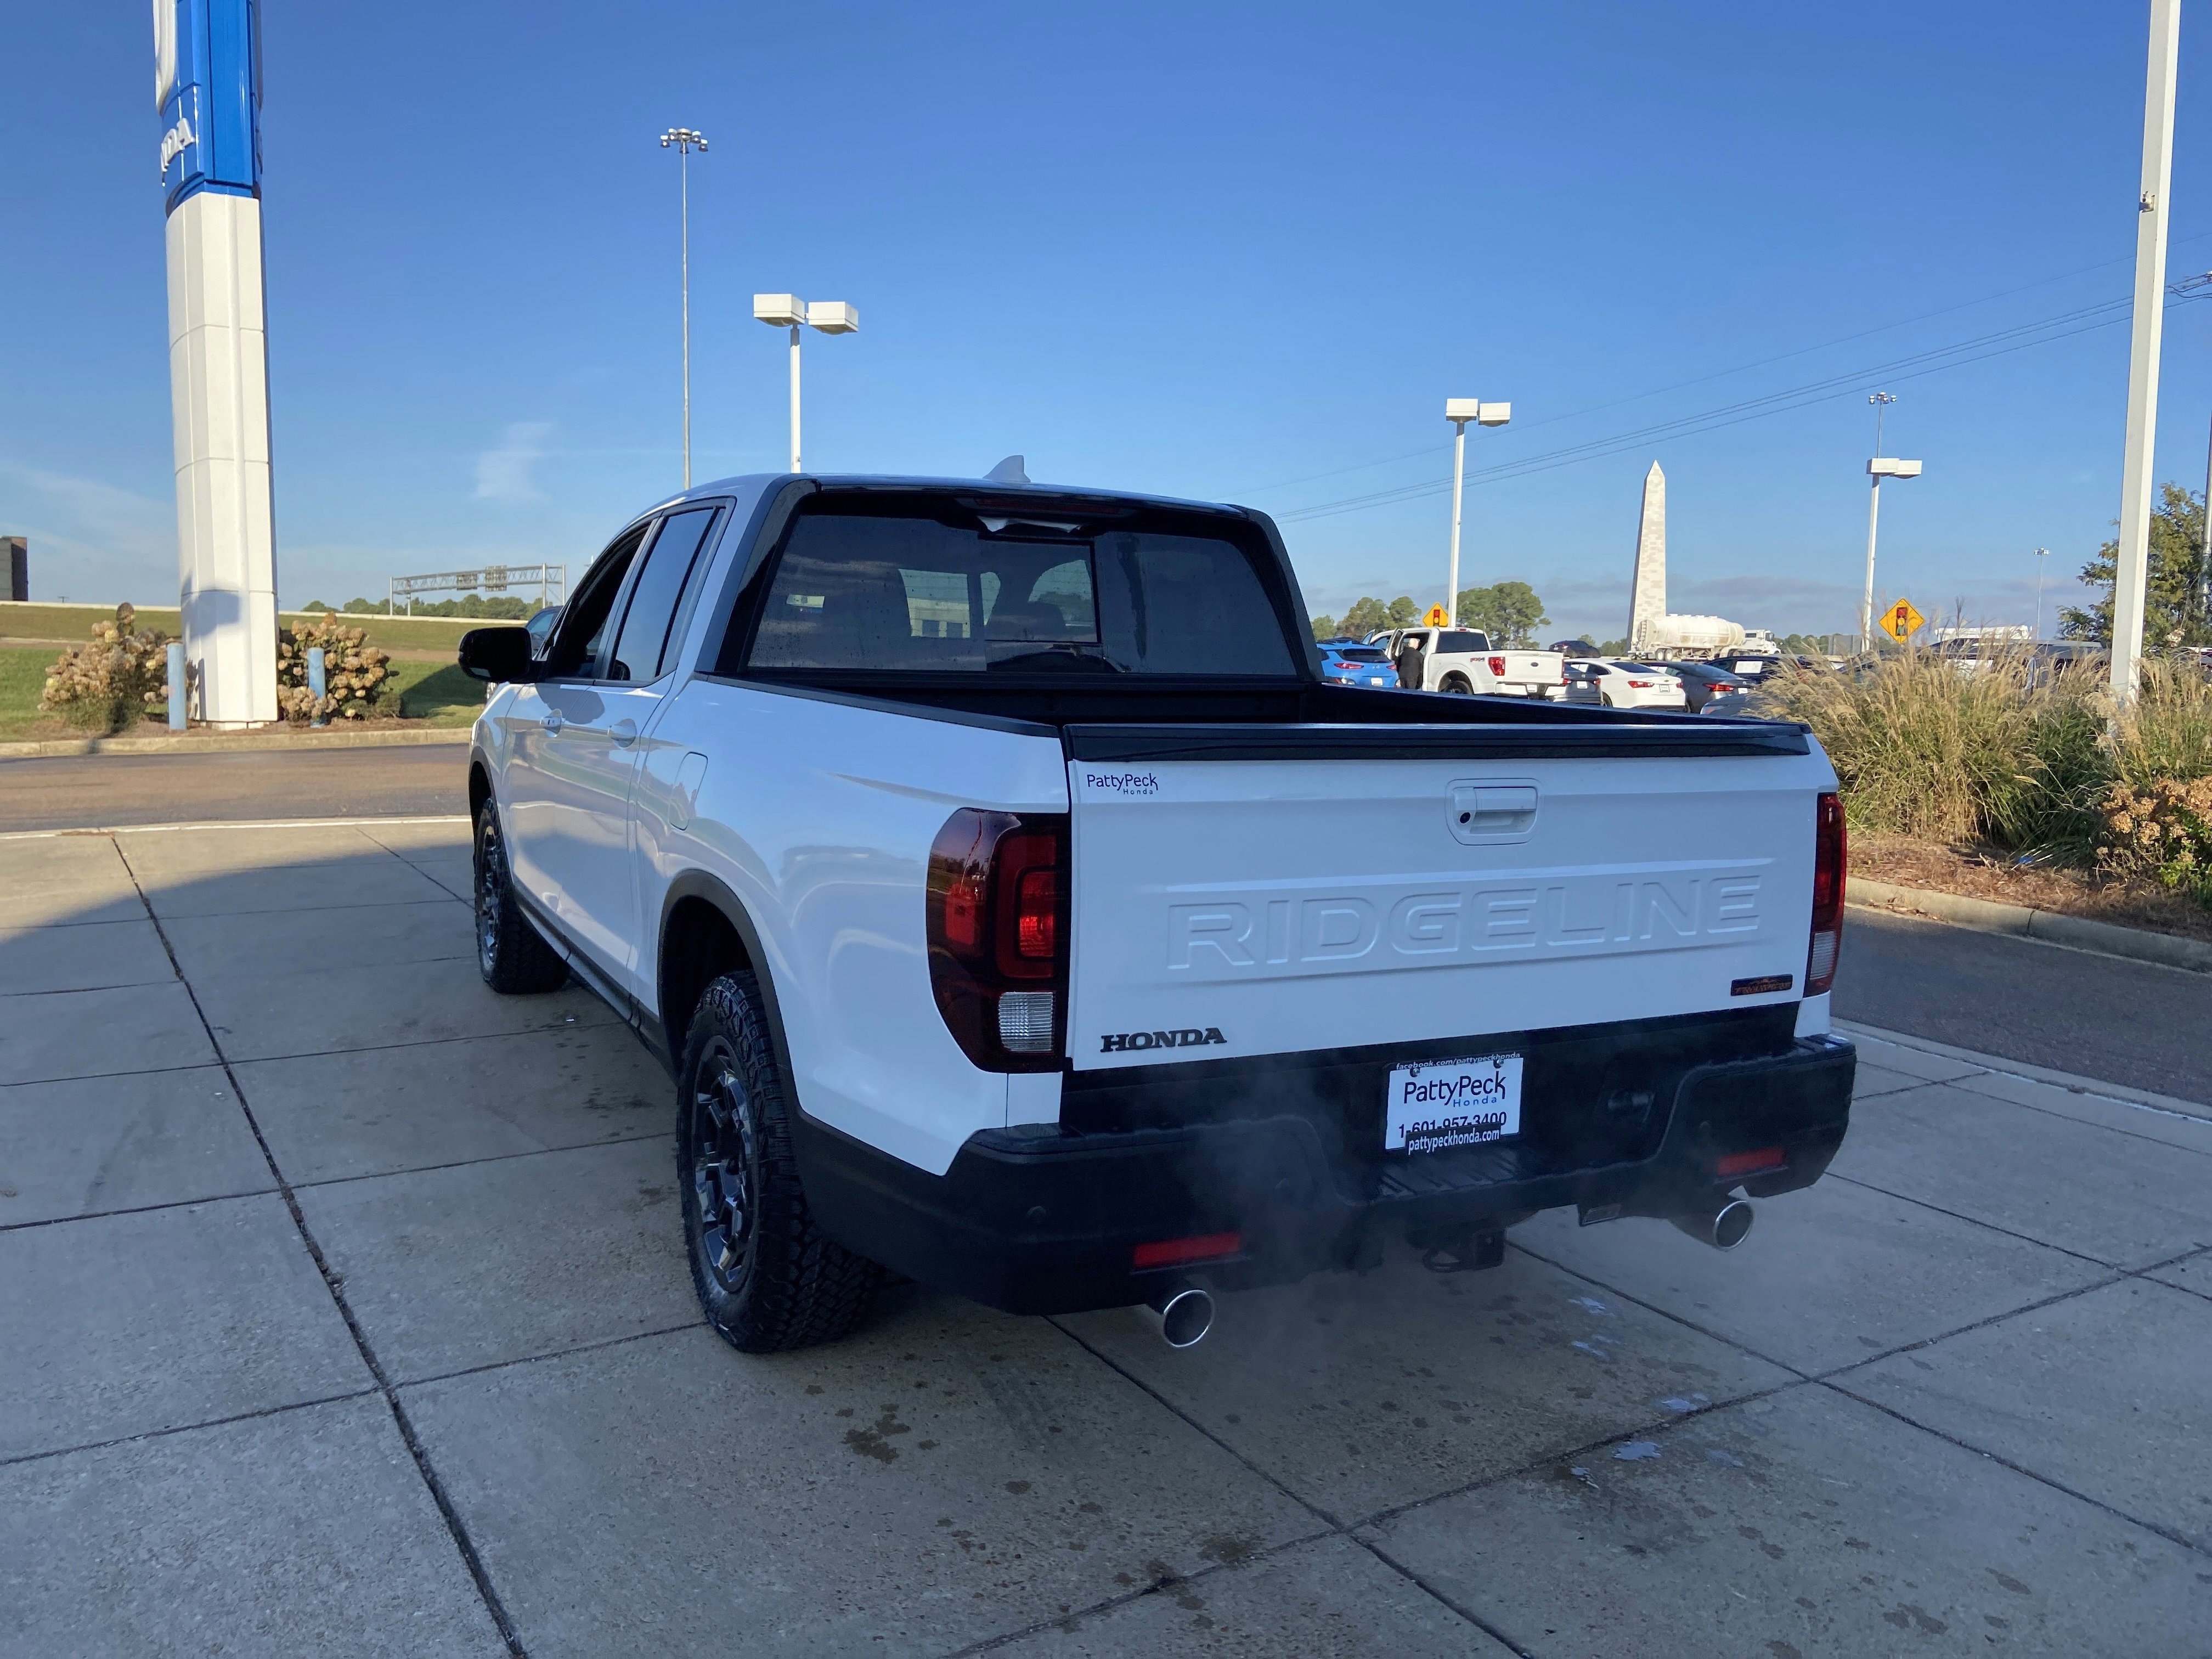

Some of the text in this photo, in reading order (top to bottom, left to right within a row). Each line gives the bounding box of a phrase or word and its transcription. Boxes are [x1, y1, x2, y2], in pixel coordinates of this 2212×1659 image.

[1087, 772, 1159, 791] PattyPeck
[1166, 874, 1762, 970] RIDGELINE
[1100, 1027, 1227, 1053] HONDA
[1396, 1052, 1520, 1070] facebook.com/pattypeckhonda
[1403, 1070, 1506, 1106] PattyPeck
[1453, 1095, 1497, 1108] Honda
[1408, 1127, 1500, 1156] pattypeckhonda.com
